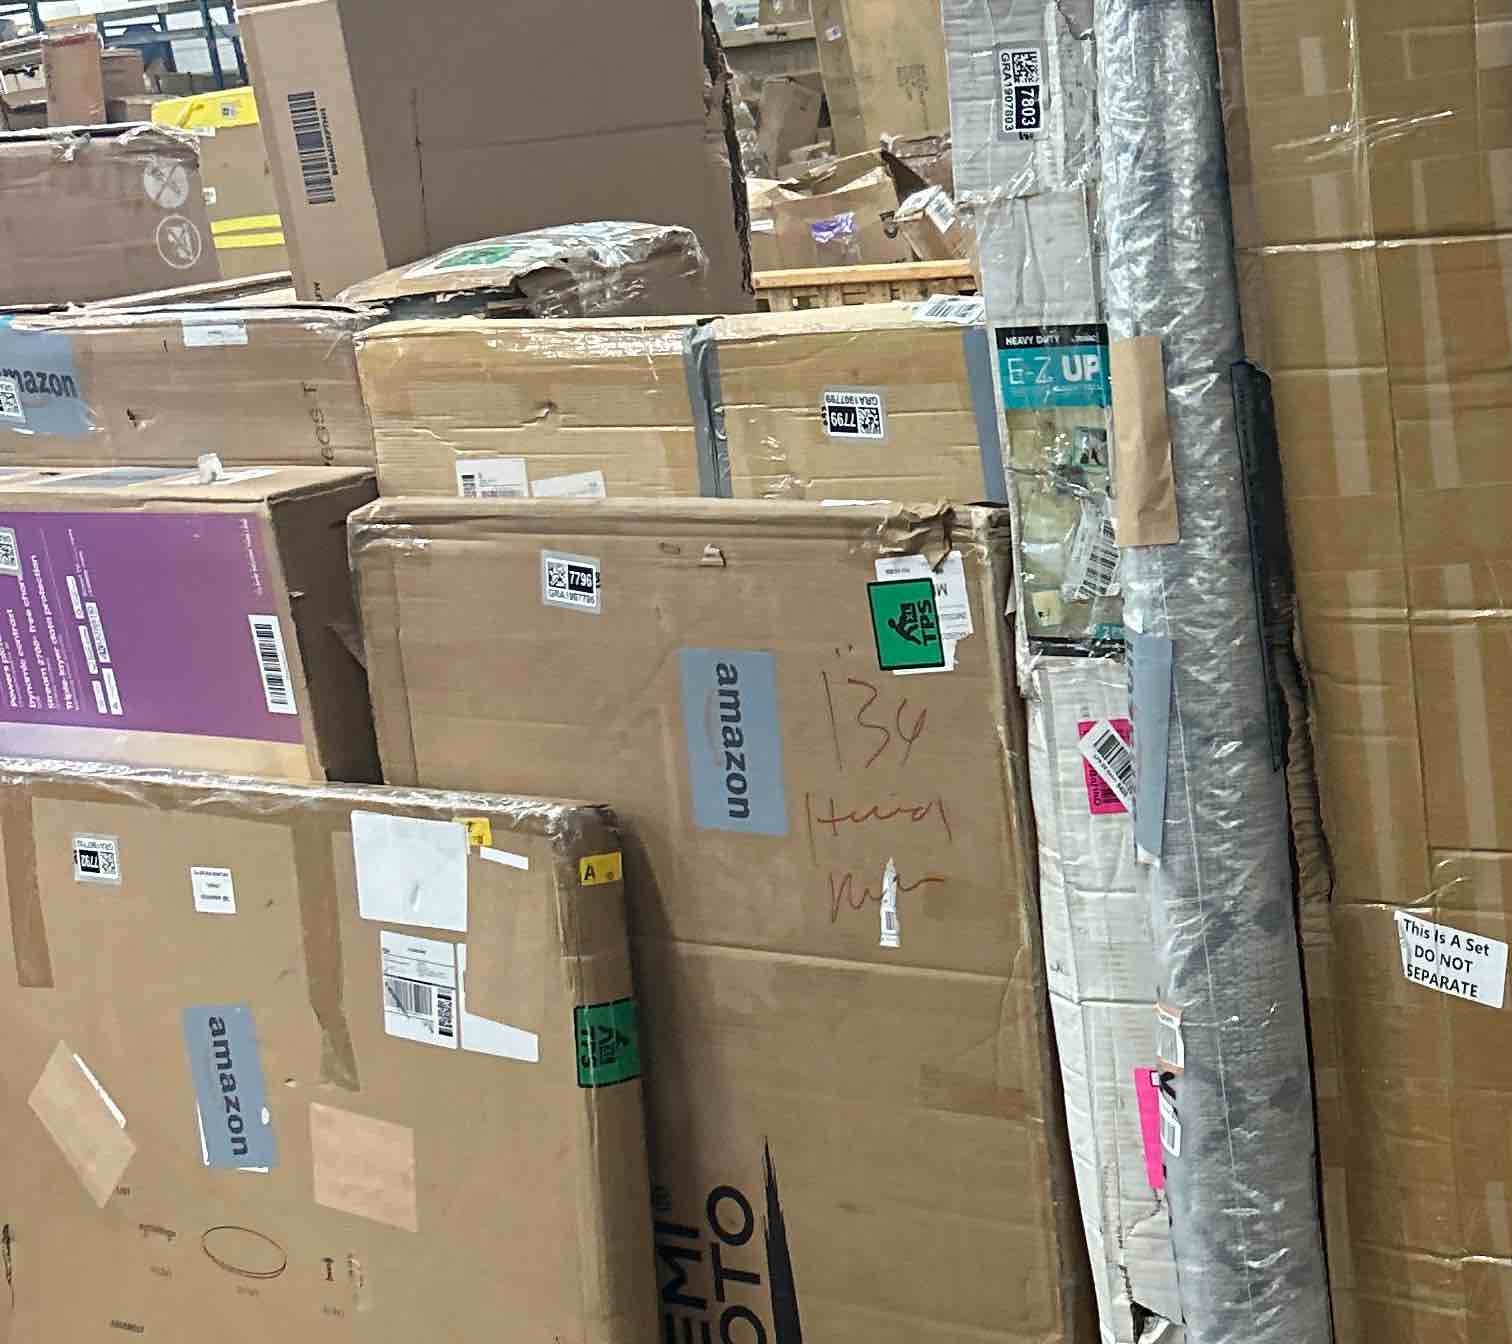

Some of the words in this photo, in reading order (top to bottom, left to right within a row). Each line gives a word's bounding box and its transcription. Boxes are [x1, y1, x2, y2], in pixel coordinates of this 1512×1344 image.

[1001, 52, 1014, 131] GRA1907803
[1021, 88, 1036, 127] 7803
[1005, 335, 1033, 346] HEAVY
[0, 367, 78, 398] mazon
[1008, 355, 1053, 385] E-Z
[1063, 354, 1100, 384] UP
[825, 392, 878, 406] GRA1907799
[830, 410, 856, 428] 7799
[569, 570, 594, 588] 7796
[918, 599, 938, 647] TPS
[716, 663, 750, 819] amazon
[583, 863, 597, 881] A
[1403, 918, 1431, 940] This
[1434, 930, 1446, 944] Is
[1450, 934, 1462, 949] A
[1465, 938, 1490, 957] Set
[1414, 944, 1436, 963] DO
[1440, 953, 1474, 974] NOT
[1407, 963, 1478, 998] SEPARATE
[209, 1016, 249, 1156] amazon
